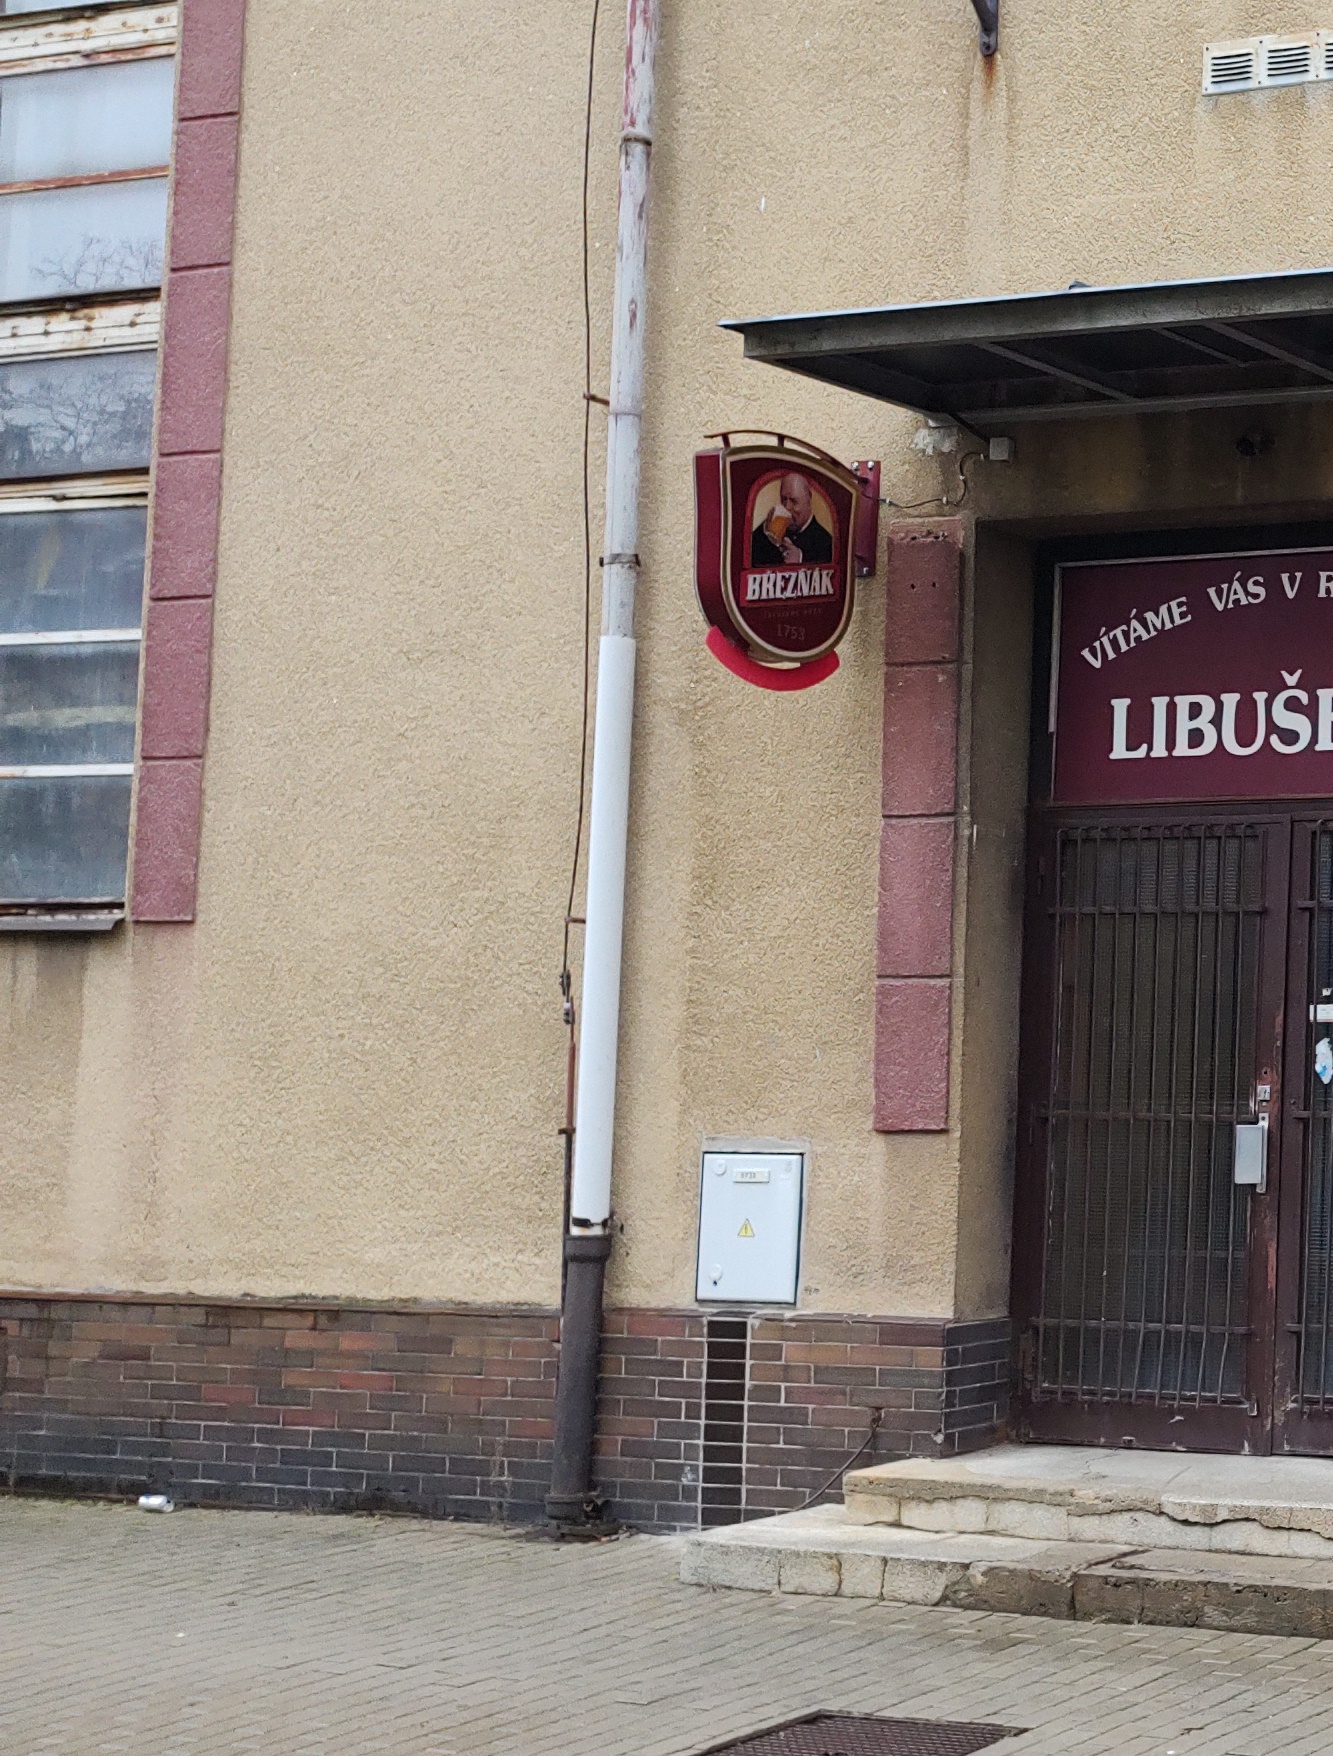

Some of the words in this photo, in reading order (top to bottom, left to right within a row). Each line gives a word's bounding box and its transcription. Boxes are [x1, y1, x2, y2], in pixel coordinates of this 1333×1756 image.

[1080, 595, 1192, 670] VÍTÁME
[1207, 571, 1267, 612] VÁS
[1279, 572, 1302, 600] V
